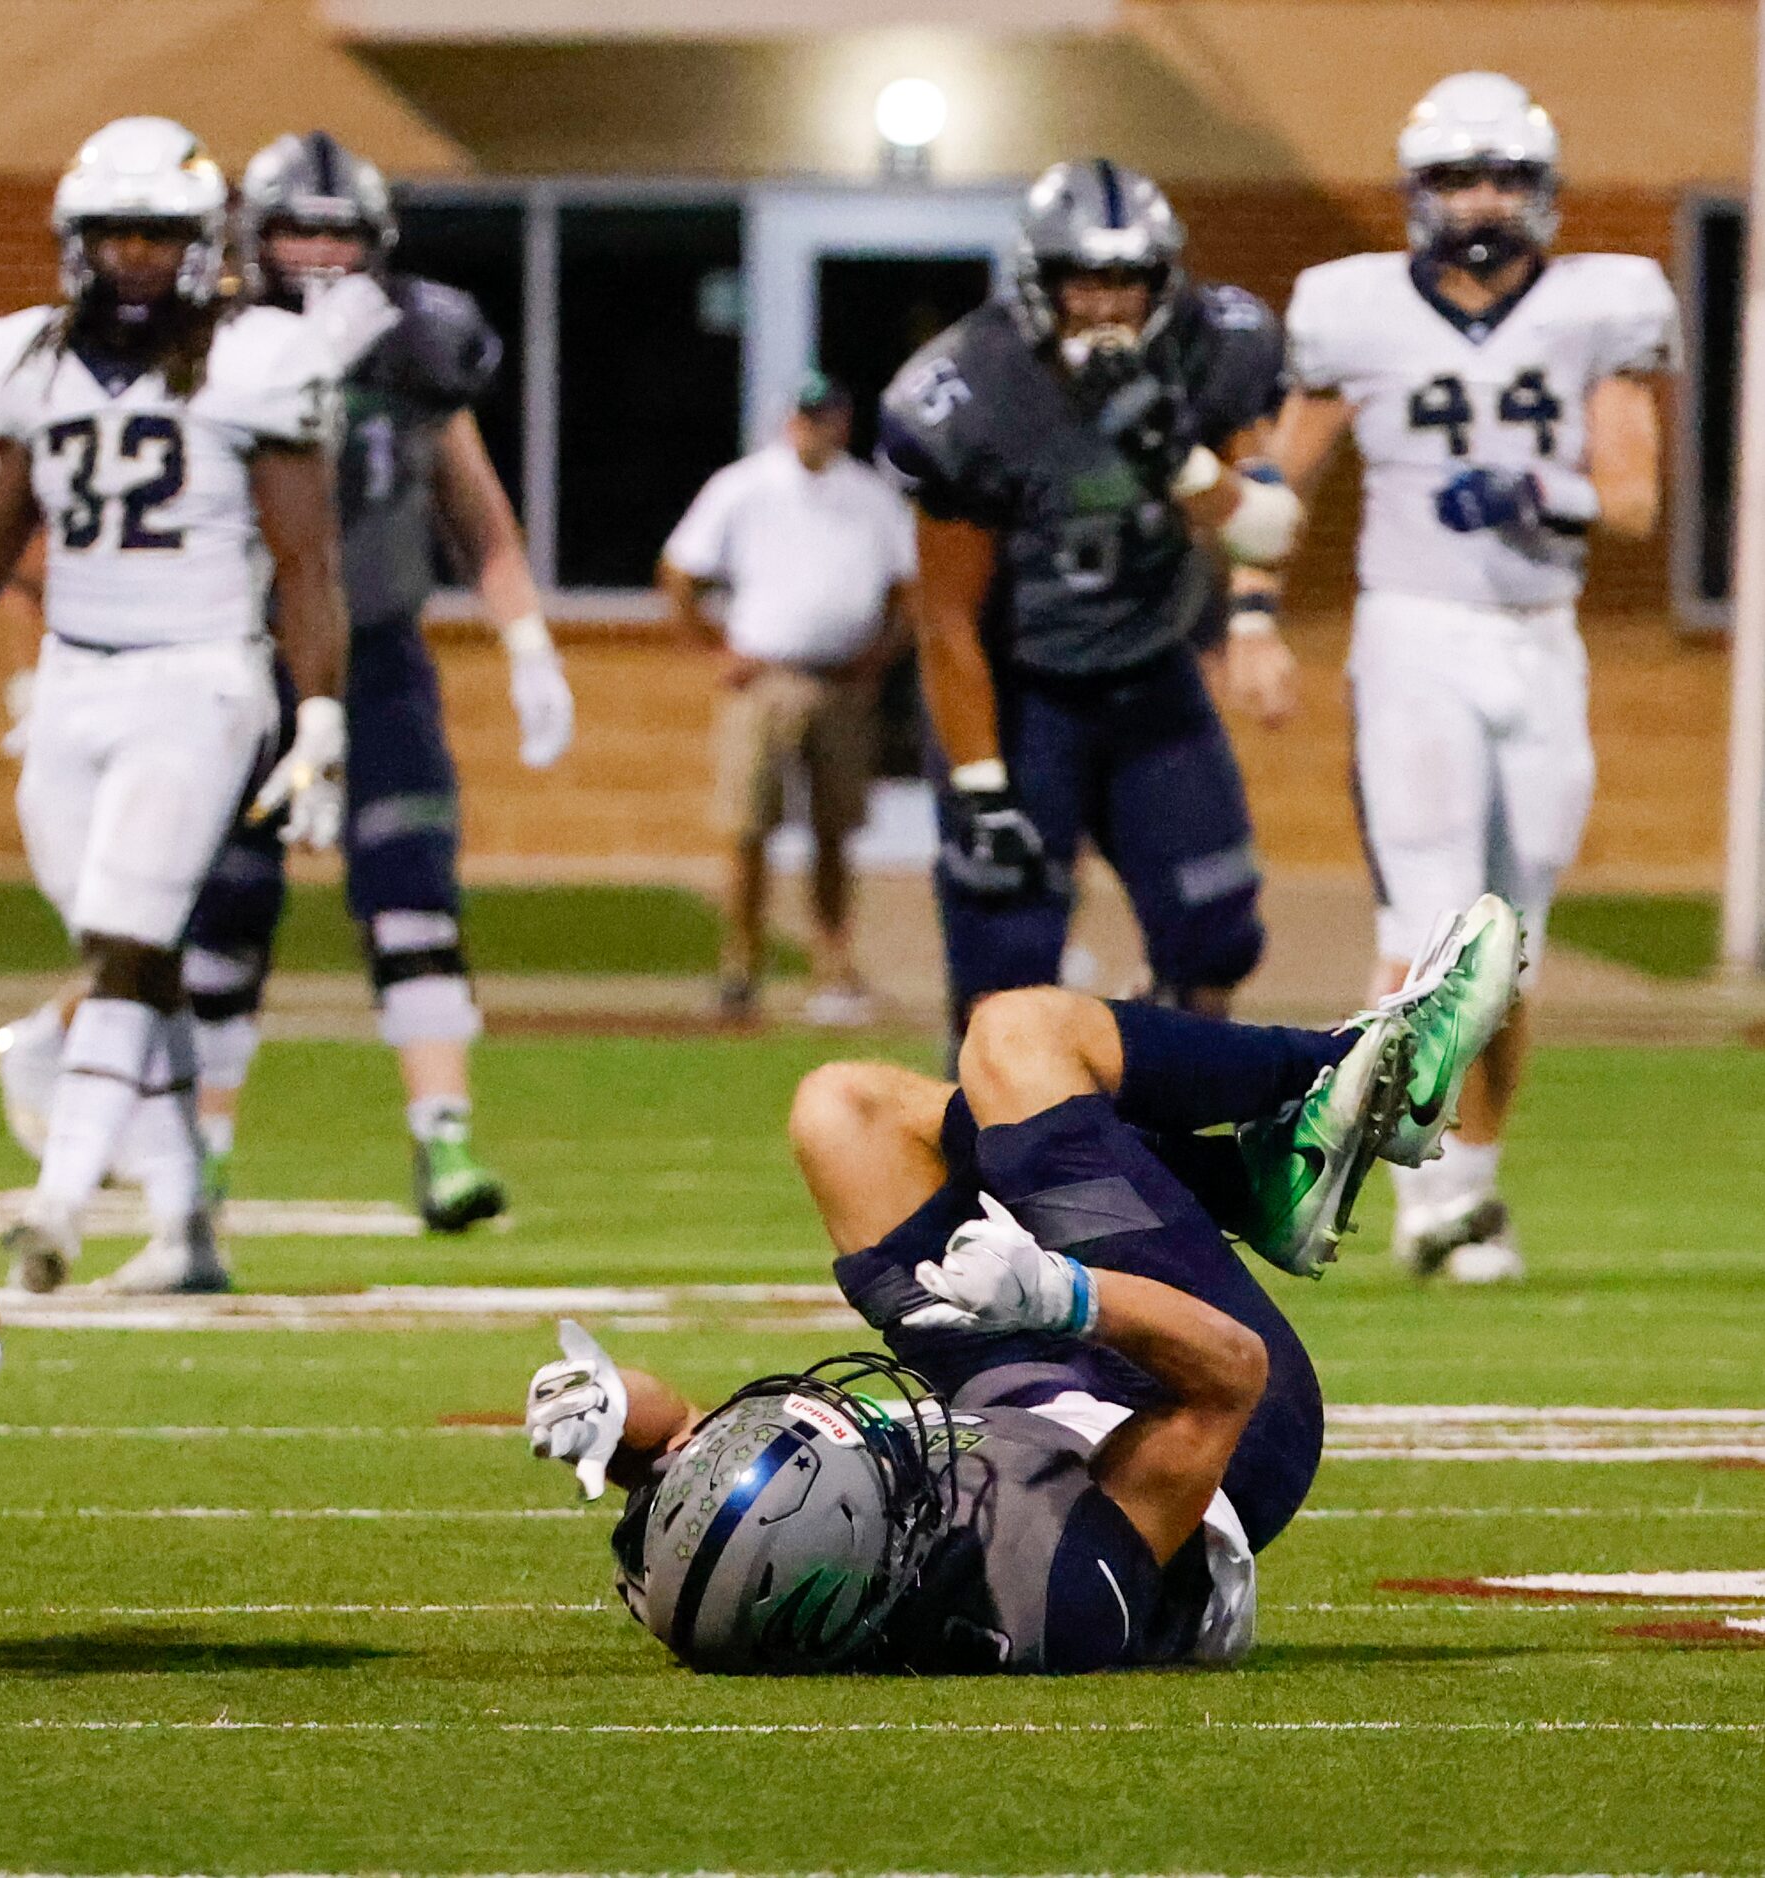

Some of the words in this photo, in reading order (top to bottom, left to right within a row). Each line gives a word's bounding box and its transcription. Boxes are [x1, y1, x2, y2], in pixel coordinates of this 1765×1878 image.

[1408, 370, 1559, 456] 44
[49, 417, 183, 549] 32
[791, 1400, 848, 1440] Riddell
